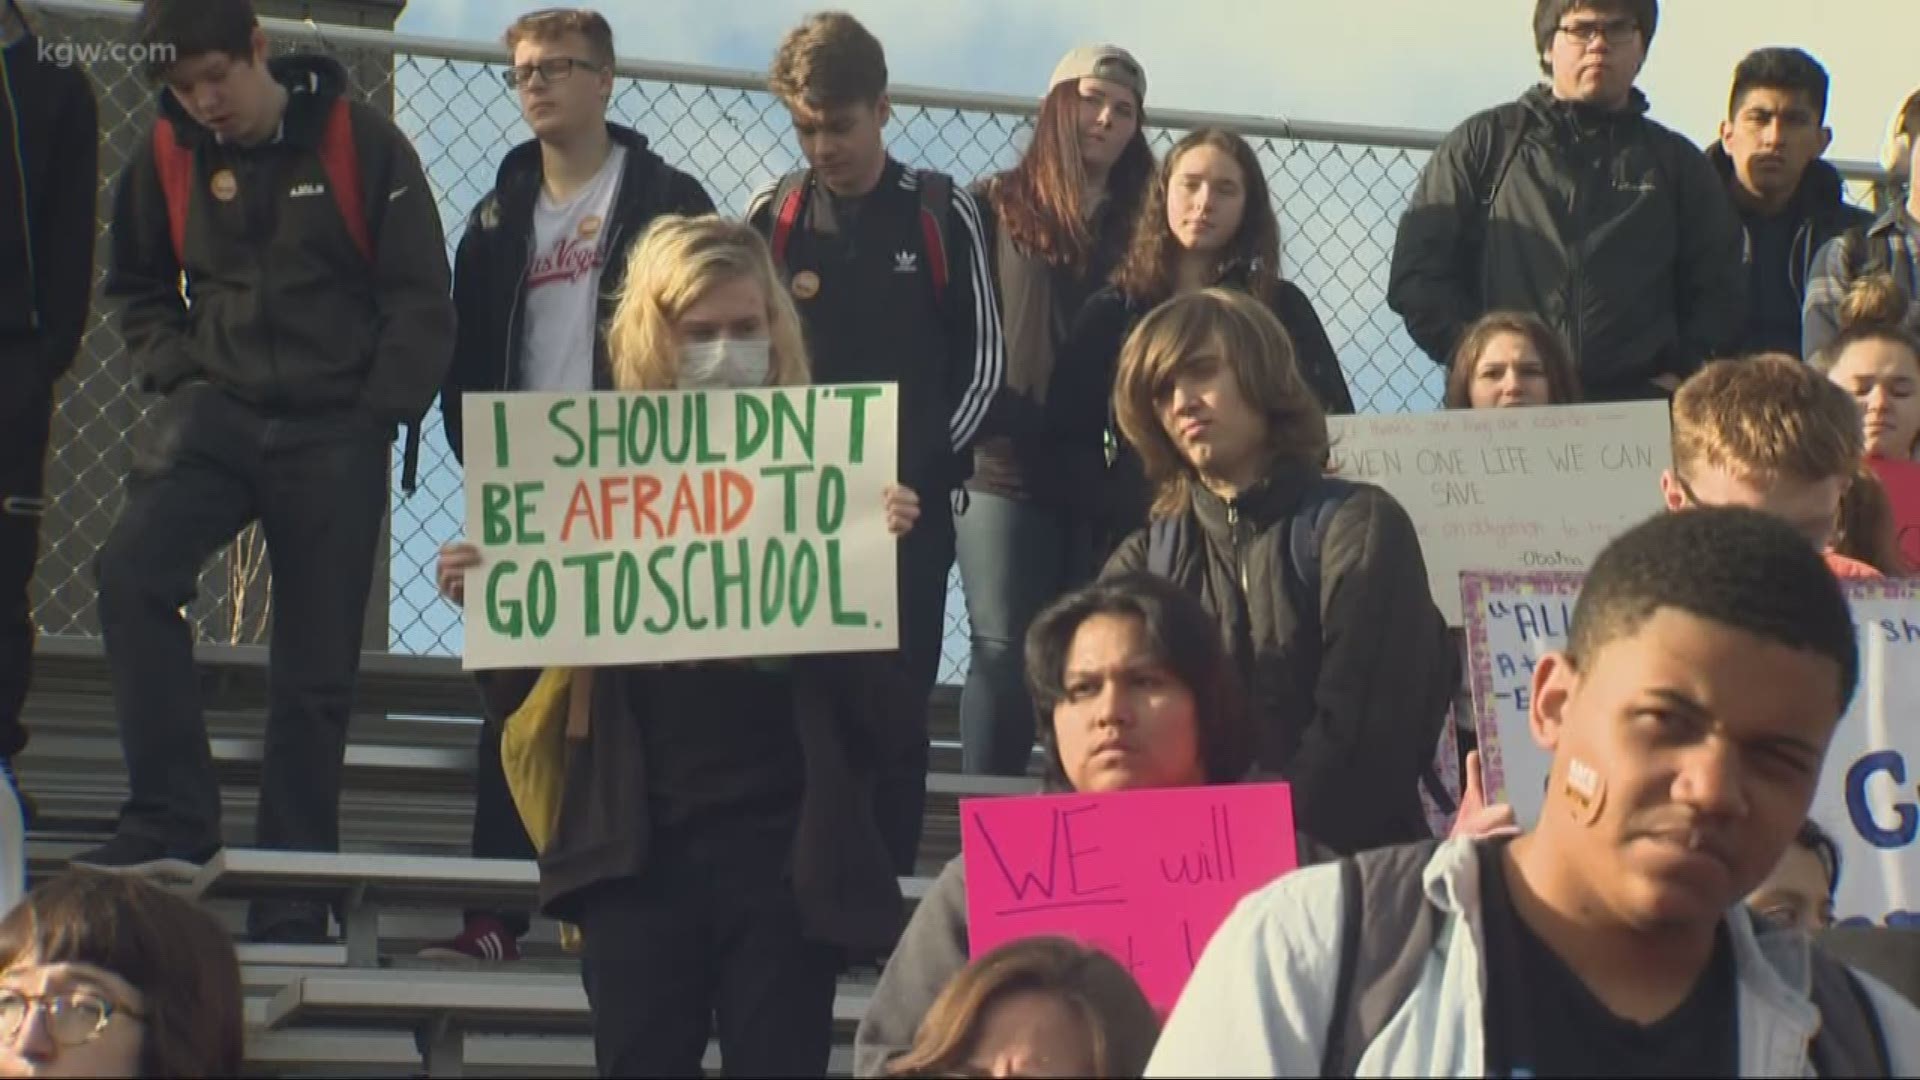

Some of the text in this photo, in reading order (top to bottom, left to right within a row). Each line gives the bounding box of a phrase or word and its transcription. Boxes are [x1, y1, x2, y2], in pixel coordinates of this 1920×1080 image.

[493, 387, 883, 468] I SHOULDN'T
[1416, 447, 1465, 476] ONE
[1481, 446, 1535, 475] LIFE
[1548, 444, 1585, 472] WE
[1601, 443, 1653, 470] CAN
[482, 464, 847, 546] BE AFRAID TO
[485, 536, 883, 639] GO TO SCHOOL.
[973, 803, 1236, 900] WE will
